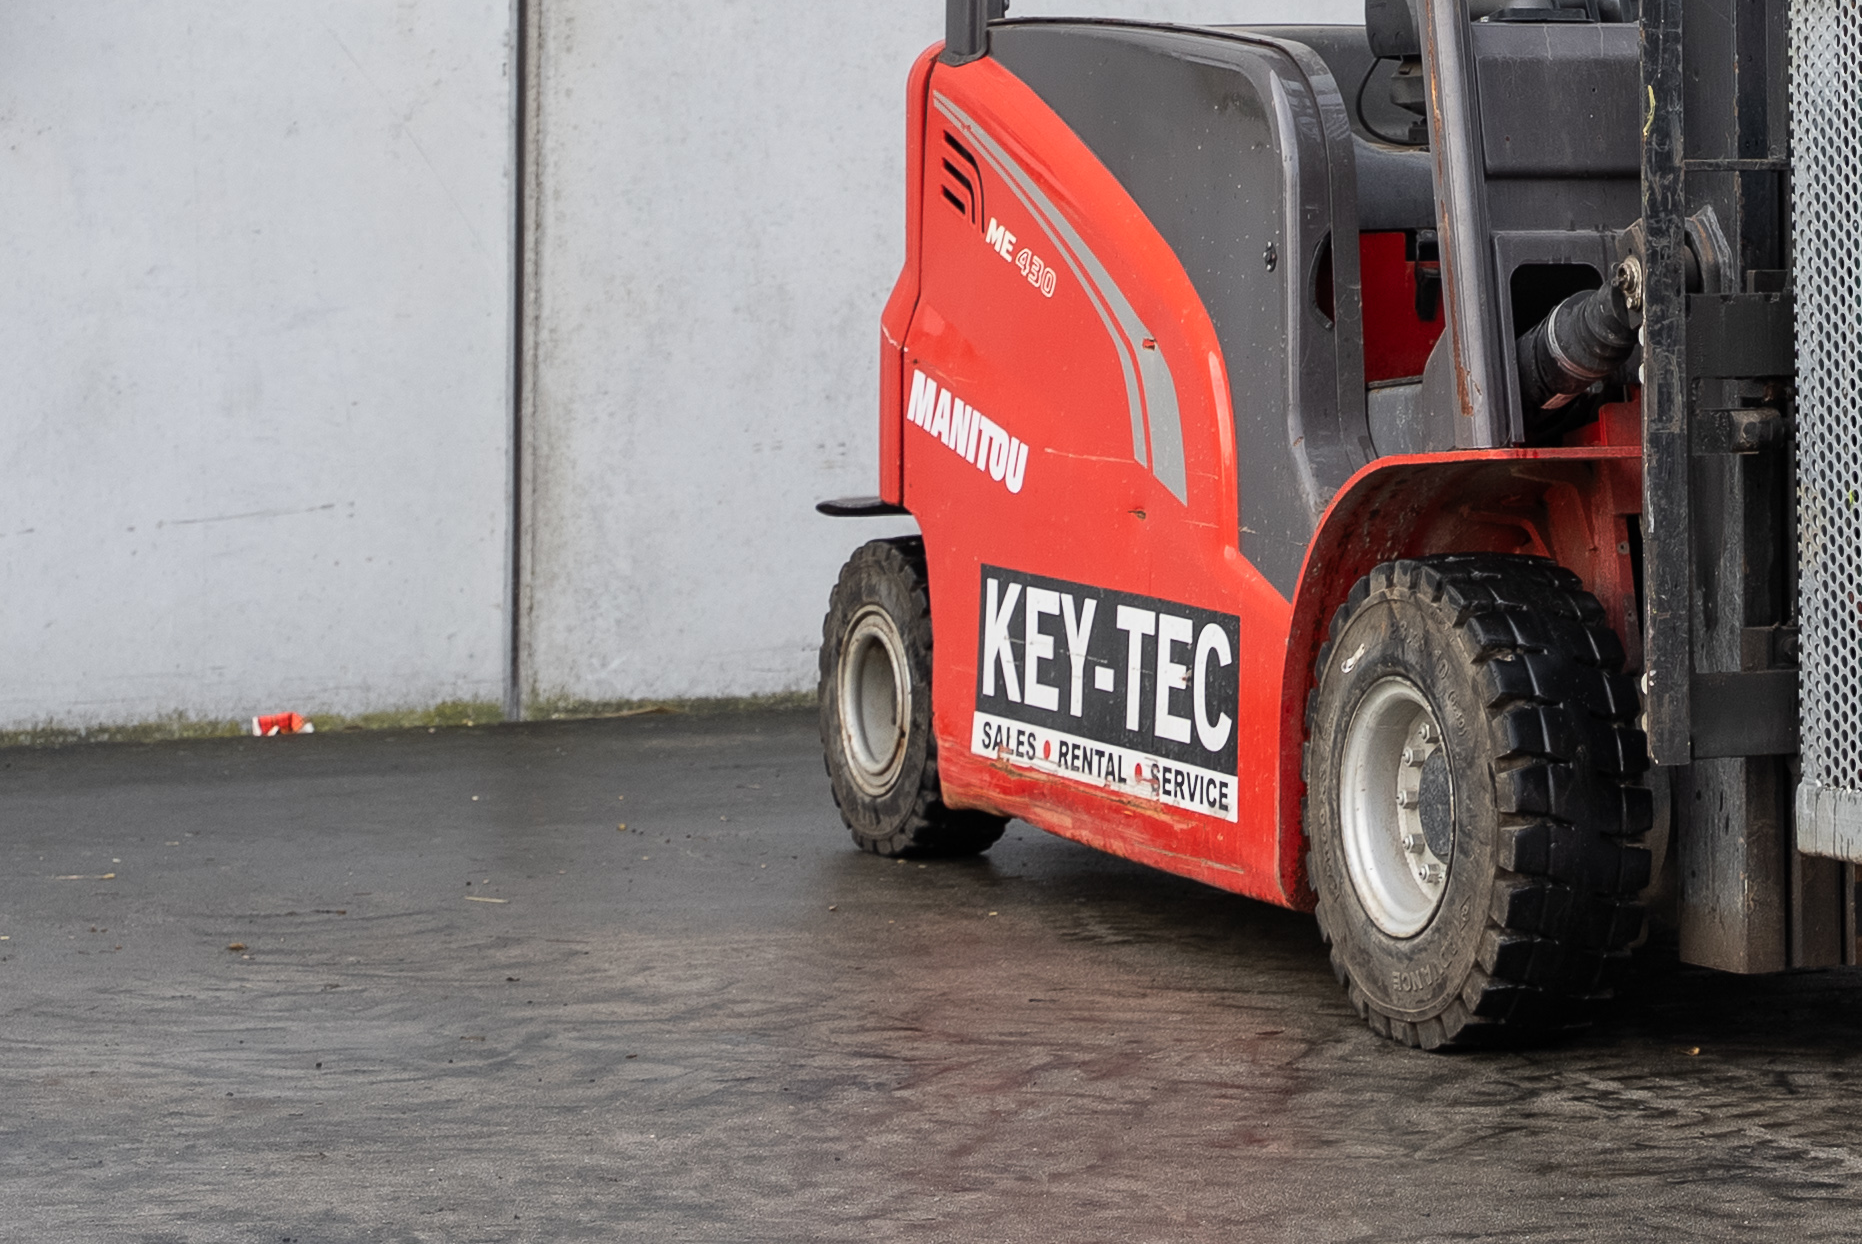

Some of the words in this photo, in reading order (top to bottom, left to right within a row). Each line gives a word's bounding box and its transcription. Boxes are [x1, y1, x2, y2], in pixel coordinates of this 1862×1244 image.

[985, 216, 1017, 263] ME
[1015, 247, 1057, 298] 430
[906, 368, 1029, 494] MANITOU
[982, 577, 1233, 752] KEY-TEC
[981, 721, 1036, 761] SALES
[1058, 739, 1127, 784] RENTAL
[1150, 762, 1230, 812] SERVICE
